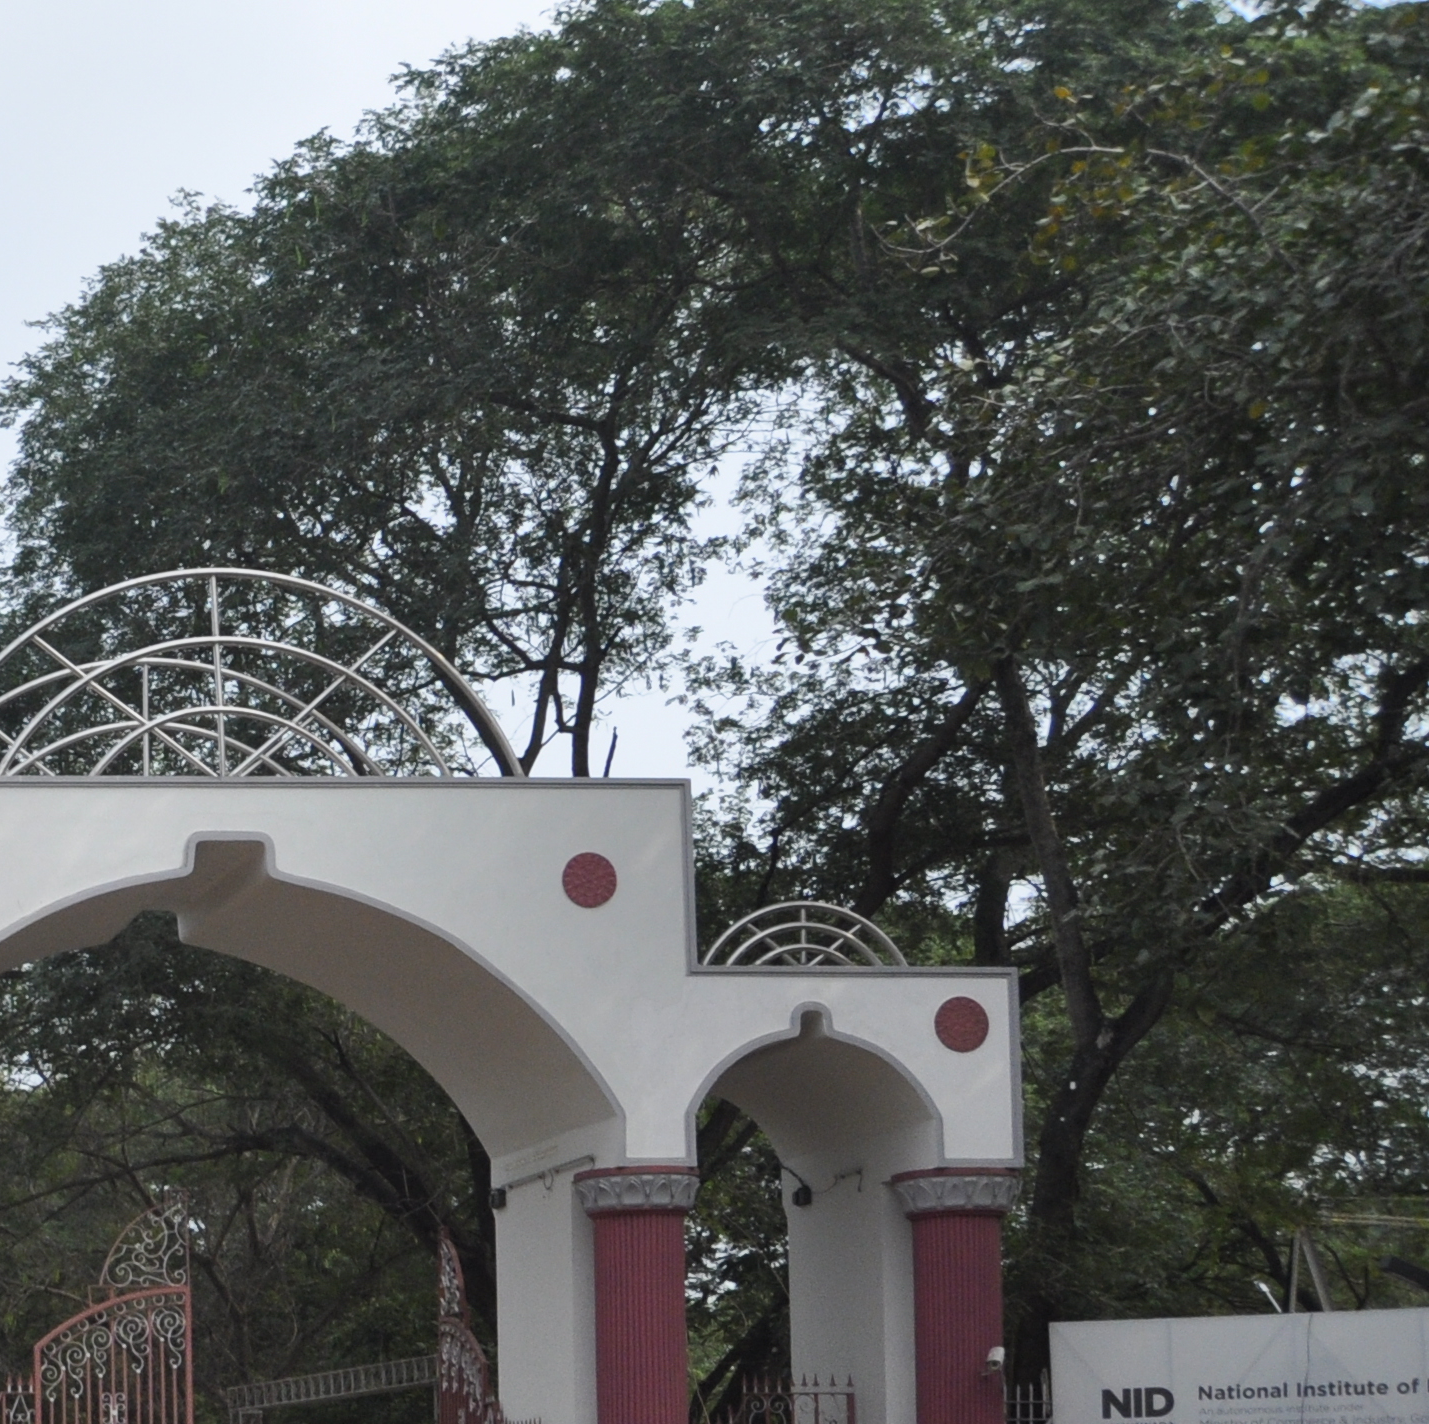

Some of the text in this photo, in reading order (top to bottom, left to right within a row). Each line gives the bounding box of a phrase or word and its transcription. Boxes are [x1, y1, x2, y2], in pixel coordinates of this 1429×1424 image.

[1102, 1386, 1175, 1420] NID
[1198, 1377, 1419, 1401] National Institute of
